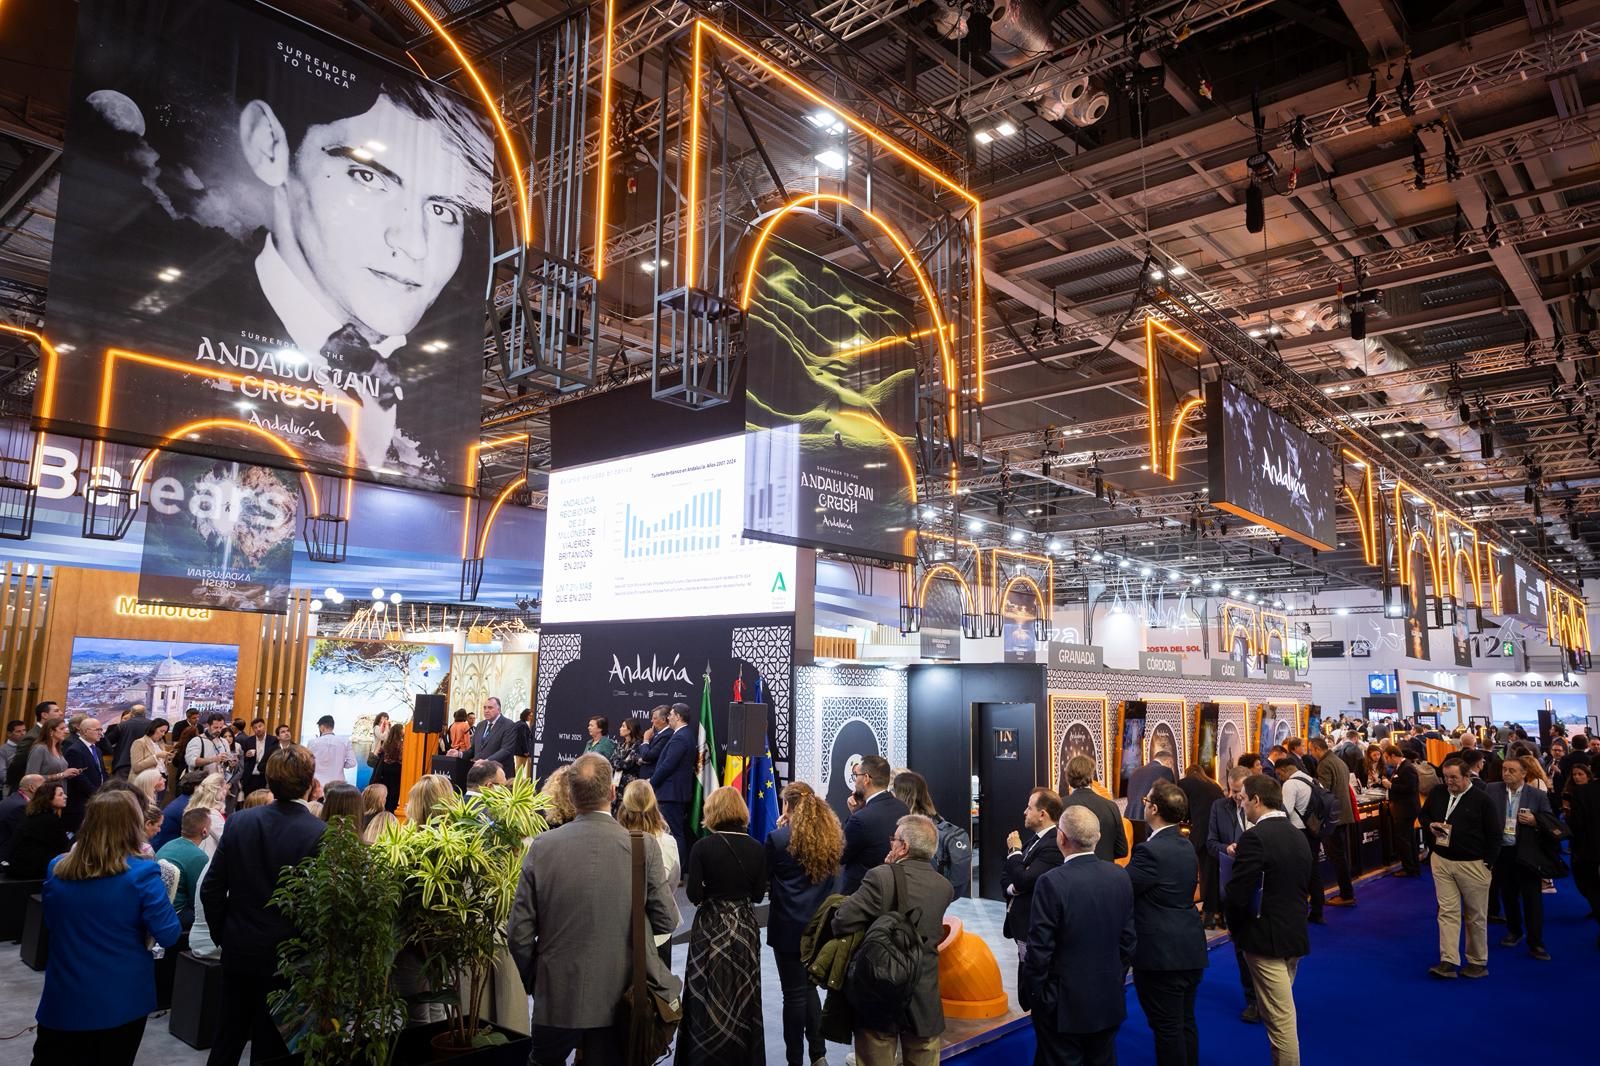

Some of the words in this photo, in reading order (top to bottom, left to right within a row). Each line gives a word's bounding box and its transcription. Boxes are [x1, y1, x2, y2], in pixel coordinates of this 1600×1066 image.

[277, 41, 356, 82] SURRENDER
[283, 54, 299, 67] TO
[307, 65, 349, 88] LORCA
[326, 351, 344, 361] THE
[240, 375, 338, 415] CRUSH
[248, 409, 326, 441] Andalucía
[1262, 446, 1310, 503] Andalucía
[800, 471, 874, 501] ANDALUSIAN
[818, 493, 858, 514] CRUSH
[1058, 649, 1096, 666] GRANADA
[1170, 645, 1185, 653] DEL
[608, 653, 694, 685] Andalucía
[1146, 656, 1177, 672] CÓRDOBA
[1530, 680, 1542, 688] DE
[1544, 680, 1579, 688] MURCIA
[631, 709, 650, 719] WTM
[558, 732, 571, 740] WTM
[571, 733, 582, 741] 2025
